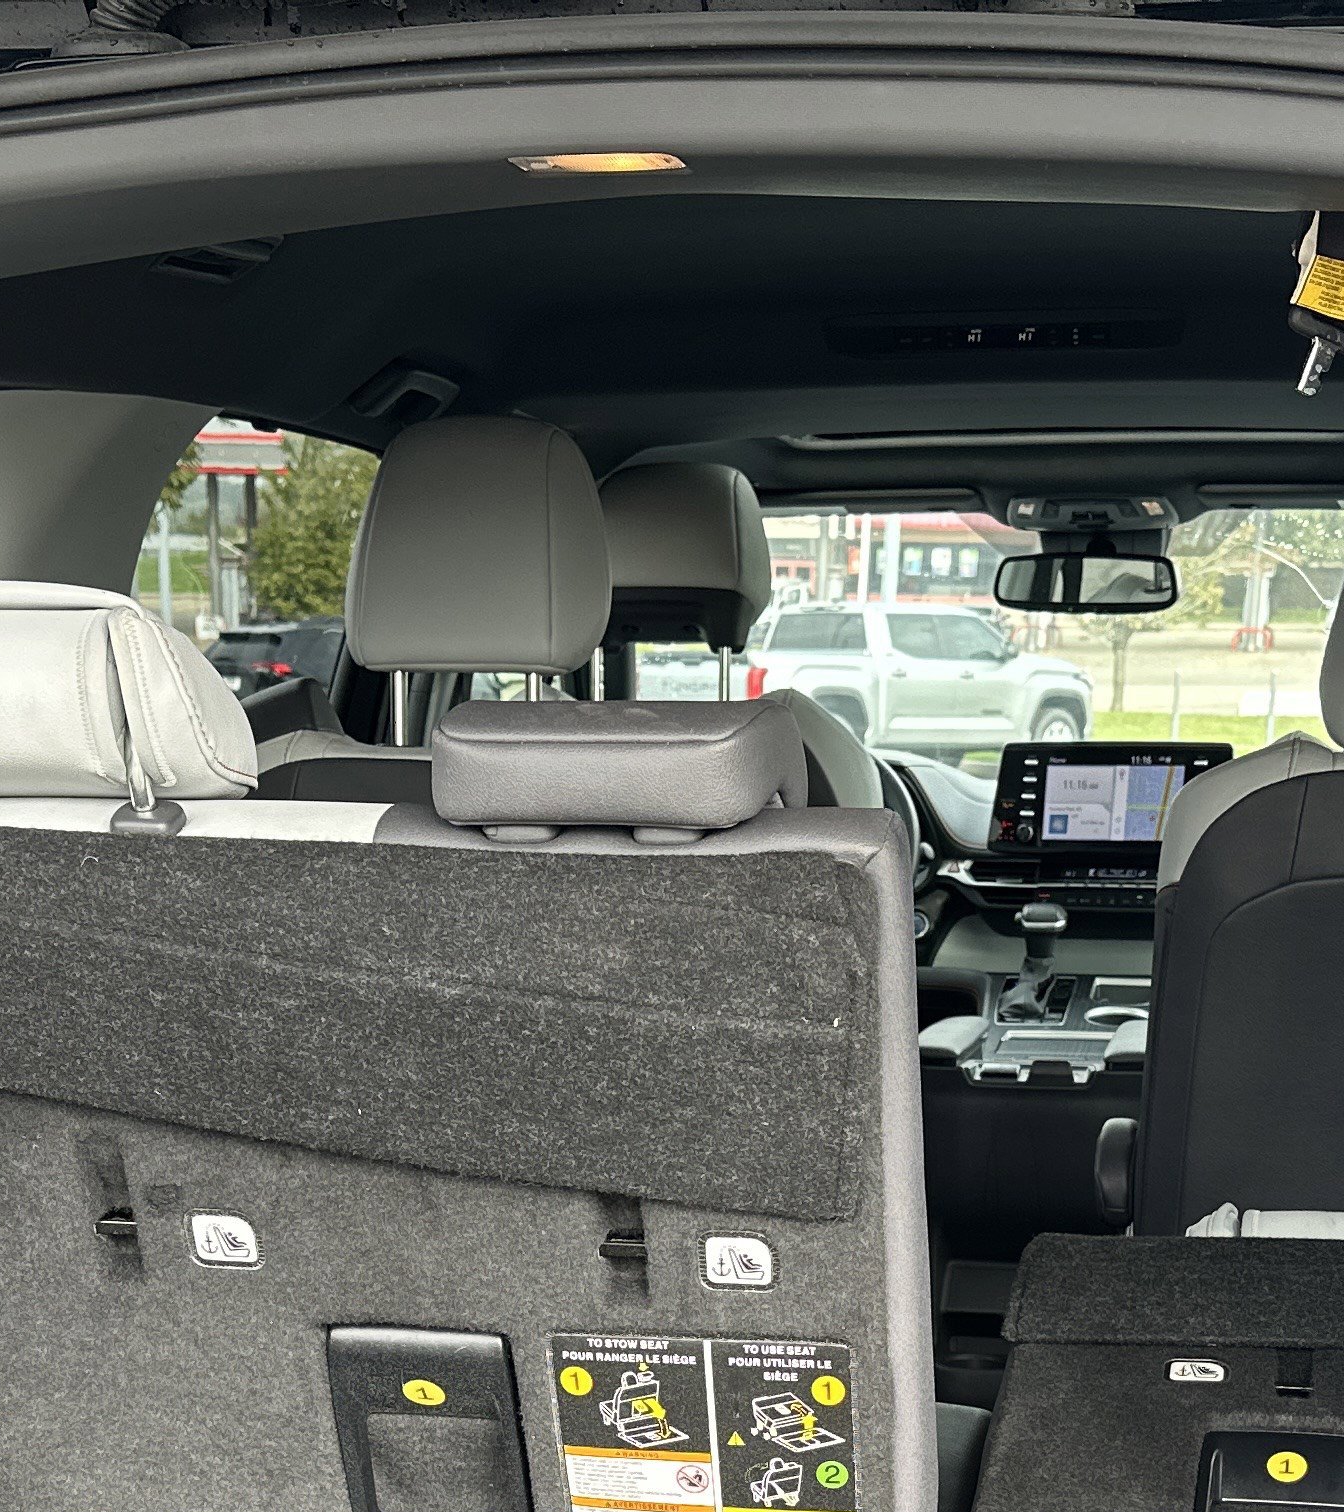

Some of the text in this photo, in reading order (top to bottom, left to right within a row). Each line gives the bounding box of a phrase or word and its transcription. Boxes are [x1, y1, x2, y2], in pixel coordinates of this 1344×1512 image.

[587, 1338, 669, 1350] TO STOW SEAT
[742, 1344, 816, 1356] TO USE SEAT
[562, 1350, 697, 1365] POUR RANGER LE SIÈGE
[728, 1357, 832, 1370] POUR UTILISER LE
[569, 1371, 580, 1391] 1
[763, 1370, 798, 1382] SIÈGE
[416, 1387, 434, 1401] 1
[822, 1381, 831, 1400] 1
[1278, 1458, 1295, 1475] 1
[824, 1464, 840, 1484] 2
